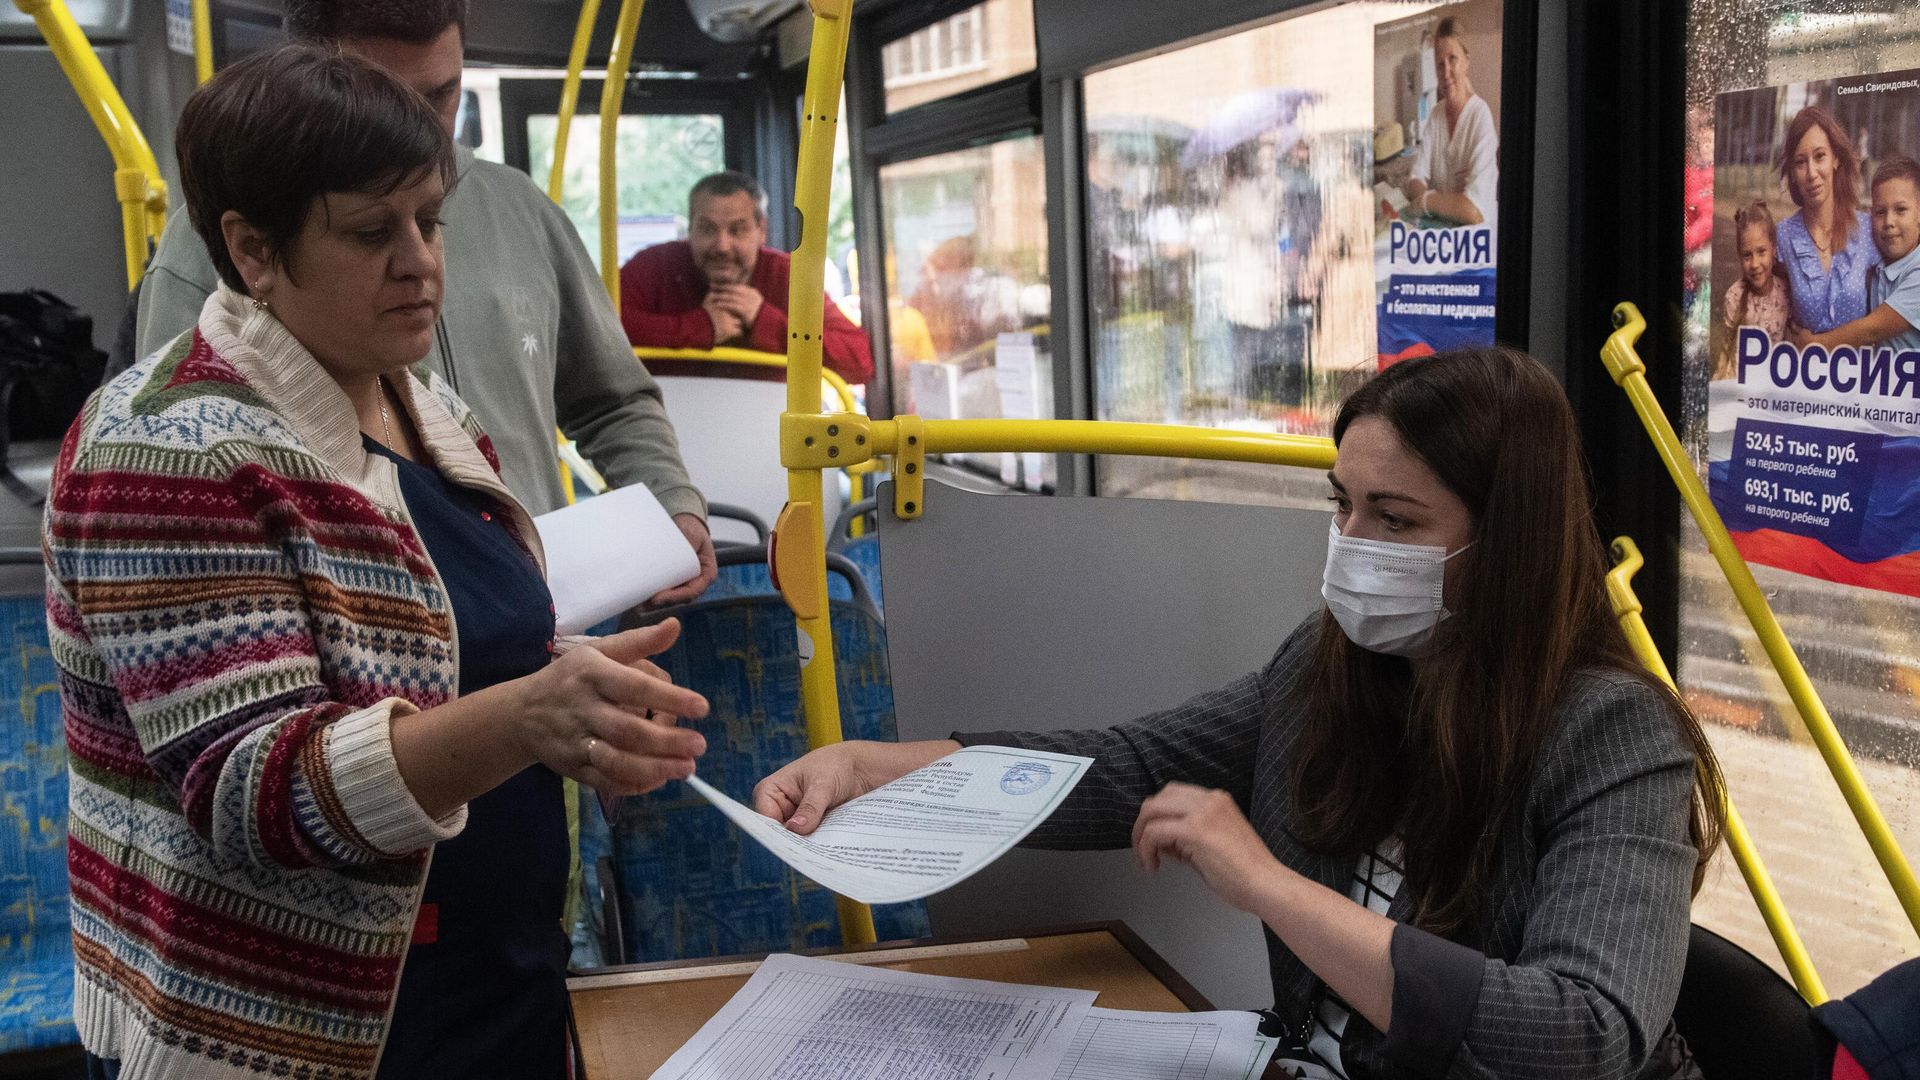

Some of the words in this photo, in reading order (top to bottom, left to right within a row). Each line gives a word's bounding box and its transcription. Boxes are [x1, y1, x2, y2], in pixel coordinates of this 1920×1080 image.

[1837, 85, 1864, 96] Семья
[1865, 79, 1920, 93] Свиридовых,
[1400, 284, 1416, 295] это
[1416, 284, 1480, 297] качественная
[1393, 299, 1442, 316] бесплатная
[1442, 304, 1496, 319] медицина
[1747, 398, 1769, 410] это
[1771, 399, 1861, 419] материнский
[1745, 431, 1784, 456] 524,5
[1787, 440, 1823, 459] тыс.
[1826, 443, 1859, 465] руб.
[1745, 458, 1756, 468] на
[1757, 459, 1794, 473] первого
[1795, 464, 1837, 479] ребенка
[1744, 478, 1779, 503] 693,1
[1782, 487, 1817, 507] тыс.
[1820, 493, 1853, 513] руб.
[1745, 504, 1756, 514] на
[1757, 506, 1791, 520] второго
[1791, 511, 1830, 527] ребенка
